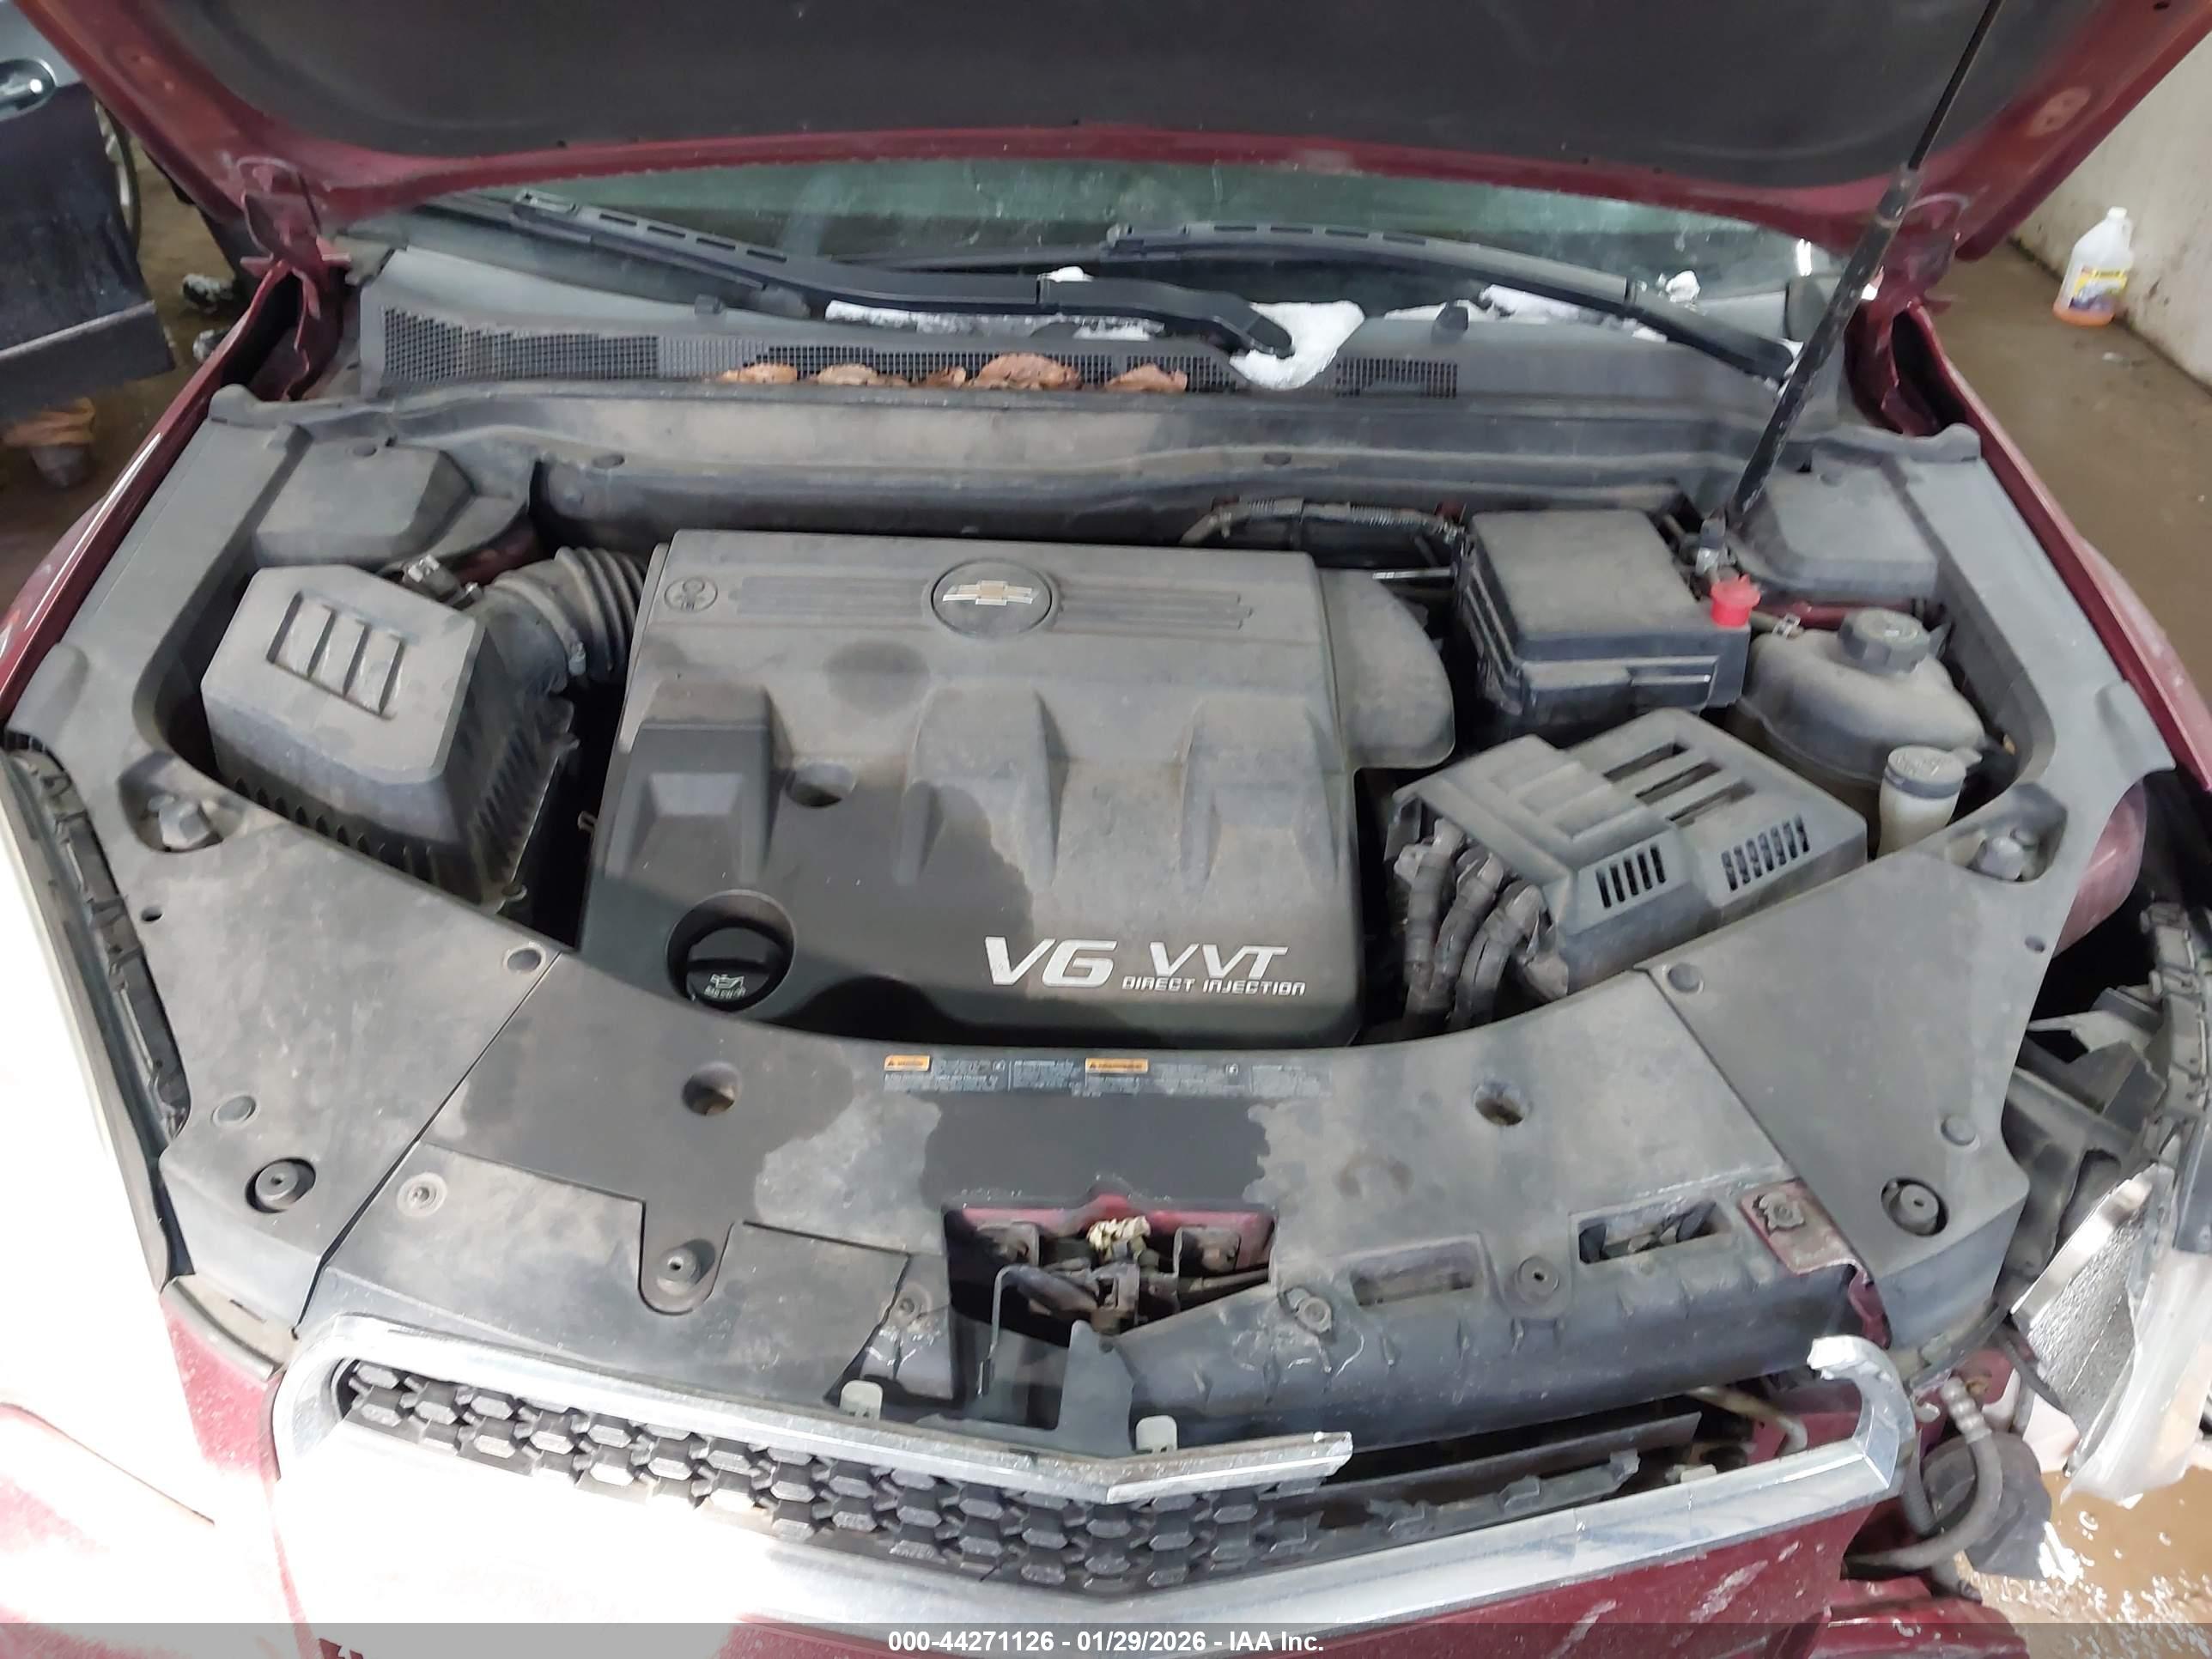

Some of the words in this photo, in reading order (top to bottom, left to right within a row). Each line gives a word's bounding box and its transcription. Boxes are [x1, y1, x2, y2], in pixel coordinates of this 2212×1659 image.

[985, 936, 1117, 988] V6
[1150, 942, 1288, 980] VVT
[1122, 975, 1195, 993] DIRECT
[1202, 979, 1305, 996] INJECTION
